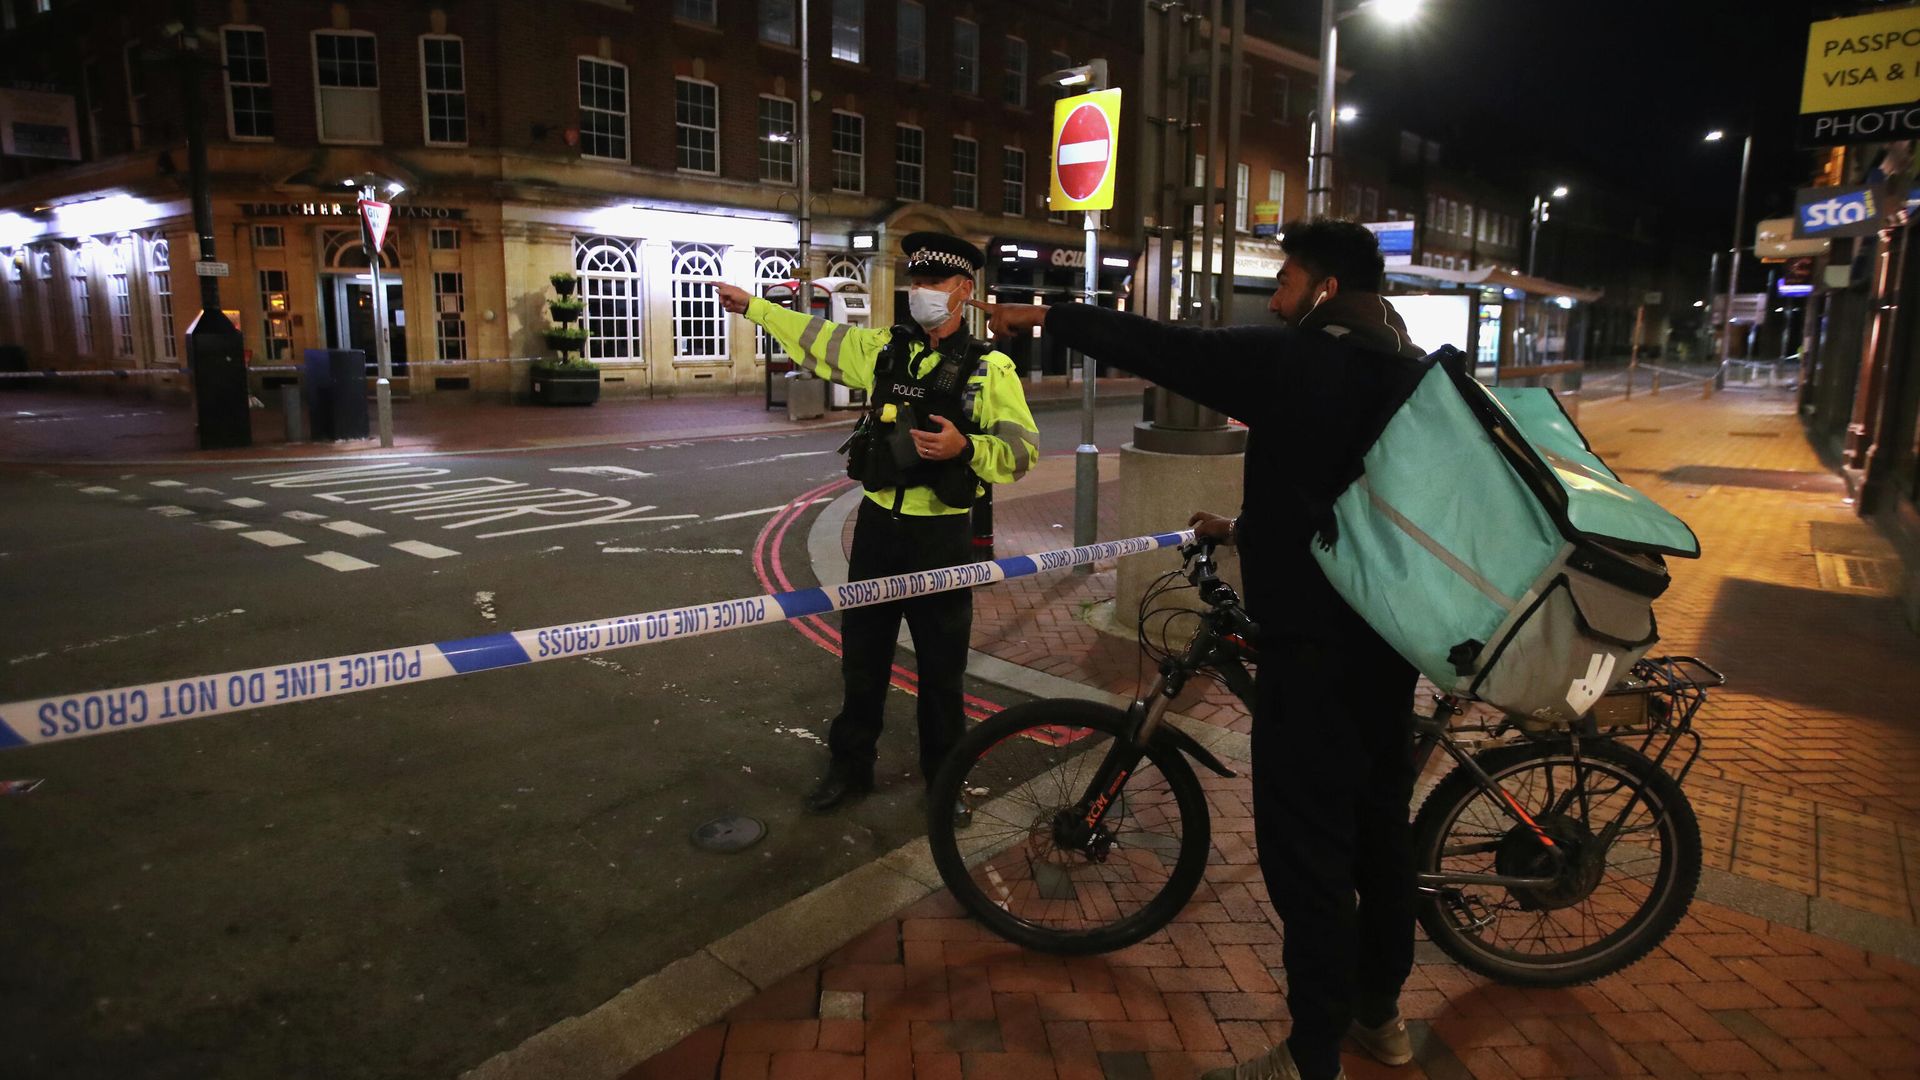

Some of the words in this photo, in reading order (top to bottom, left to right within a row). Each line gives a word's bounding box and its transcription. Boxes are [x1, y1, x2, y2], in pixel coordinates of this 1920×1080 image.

[1822, 66, 1878, 87] VISA
[1885, 63, 1905, 81] &
[252, 203, 343, 216] PITCHER
[396, 205, 451, 218] IANO
[1803, 198, 1865, 227] sta
[892, 383, 926, 398] POLICE
[231, 462, 451, 488] NO
[311, 477, 700, 538] ENTRY
[1040, 550, 1071, 570] CROSS
[1072, 547, 1089, 564] NOT
[1089, 546, 1104, 561] DO
[910, 574, 926, 594] DO
[927, 570, 953, 591] LINE
[954, 563, 992, 586] POLICE
[838, 581, 880, 607] CROSS
[883, 577, 907, 599] NOT
[646, 613, 669, 640] DO
[673, 607, 709, 635] LINE
[713, 598, 765, 629] POLICE
[538, 623, 600, 657] CROSS
[605, 617, 640, 646] NOT
[275, 663, 331, 700] LINE
[339, 649, 421, 690] POLICE
[160, 679, 218, 719] NOT
[228, 672, 265, 707] DO
[38, 690, 148, 737] CROSS
